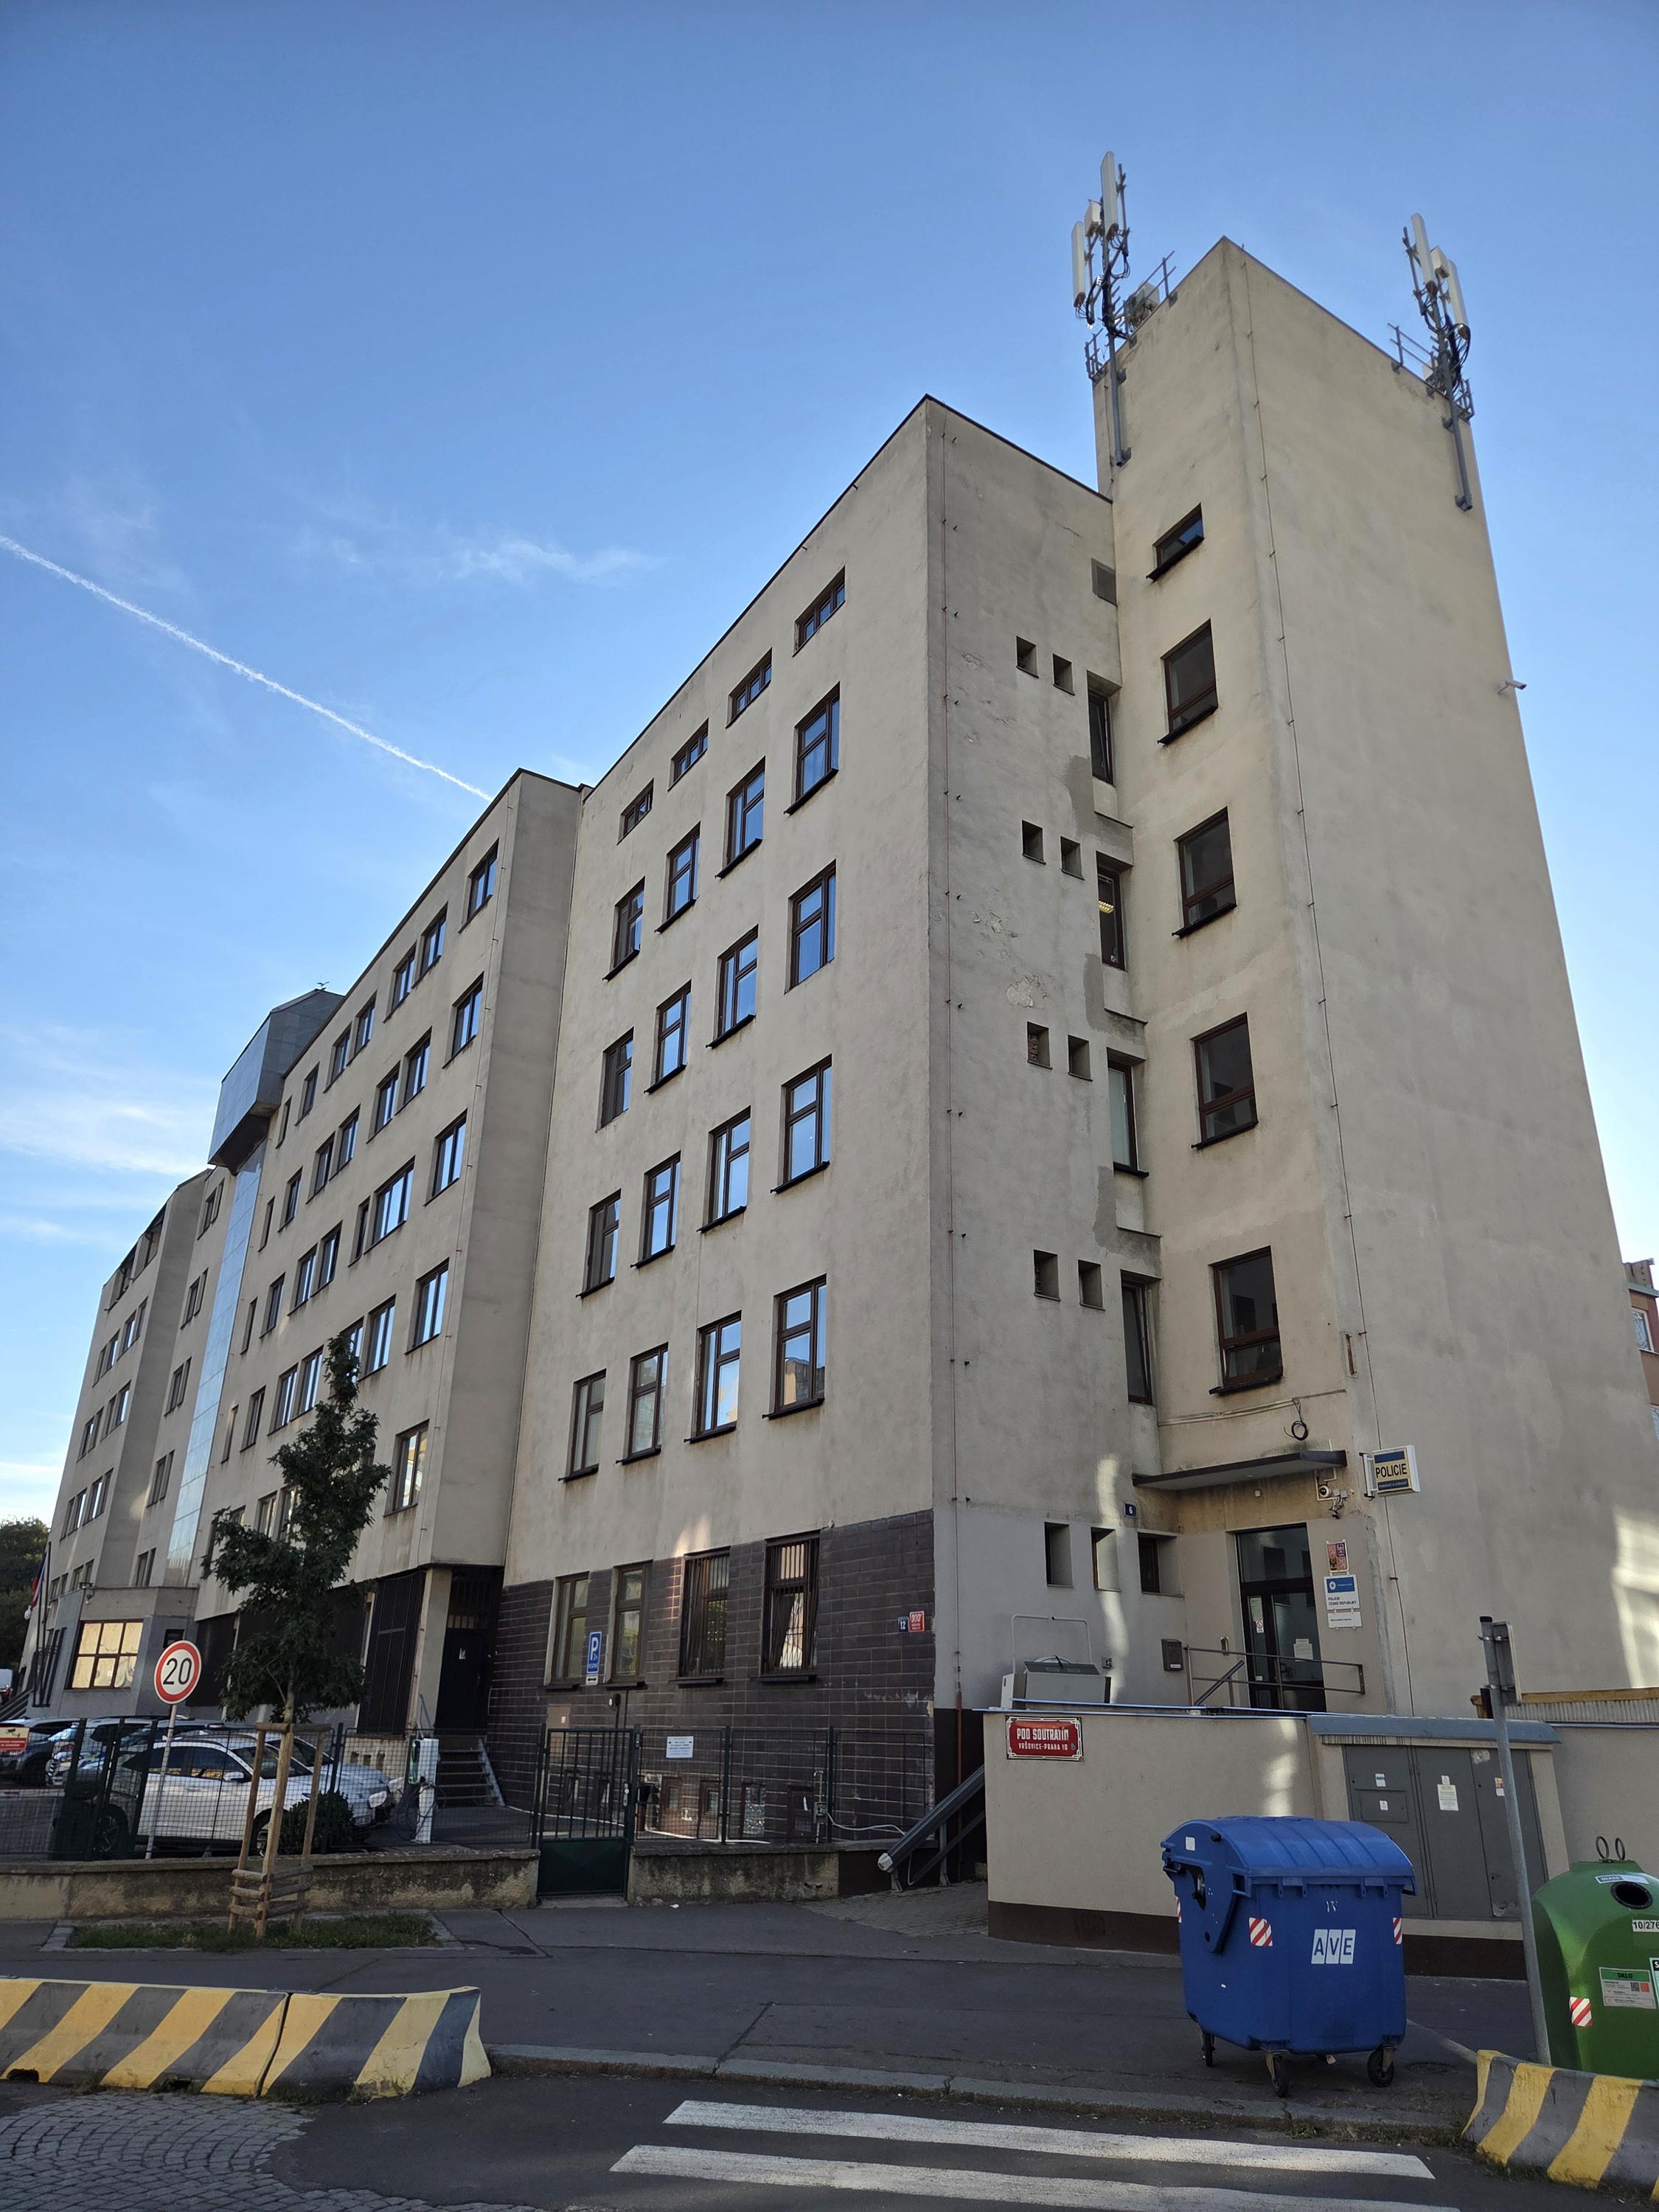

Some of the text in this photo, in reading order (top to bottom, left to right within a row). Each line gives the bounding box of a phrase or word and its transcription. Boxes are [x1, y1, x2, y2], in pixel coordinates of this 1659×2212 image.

[1375, 1463, 1408, 1478] POLICIE
[900, 1621, 906, 1630] 12
[591, 1637, 599, 1660] P
[163, 1658, 192, 1686] 20
[1017, 1727, 1069, 1741] POD SOUTRATÍM
[1314, 1937, 1353, 1955] AVE
